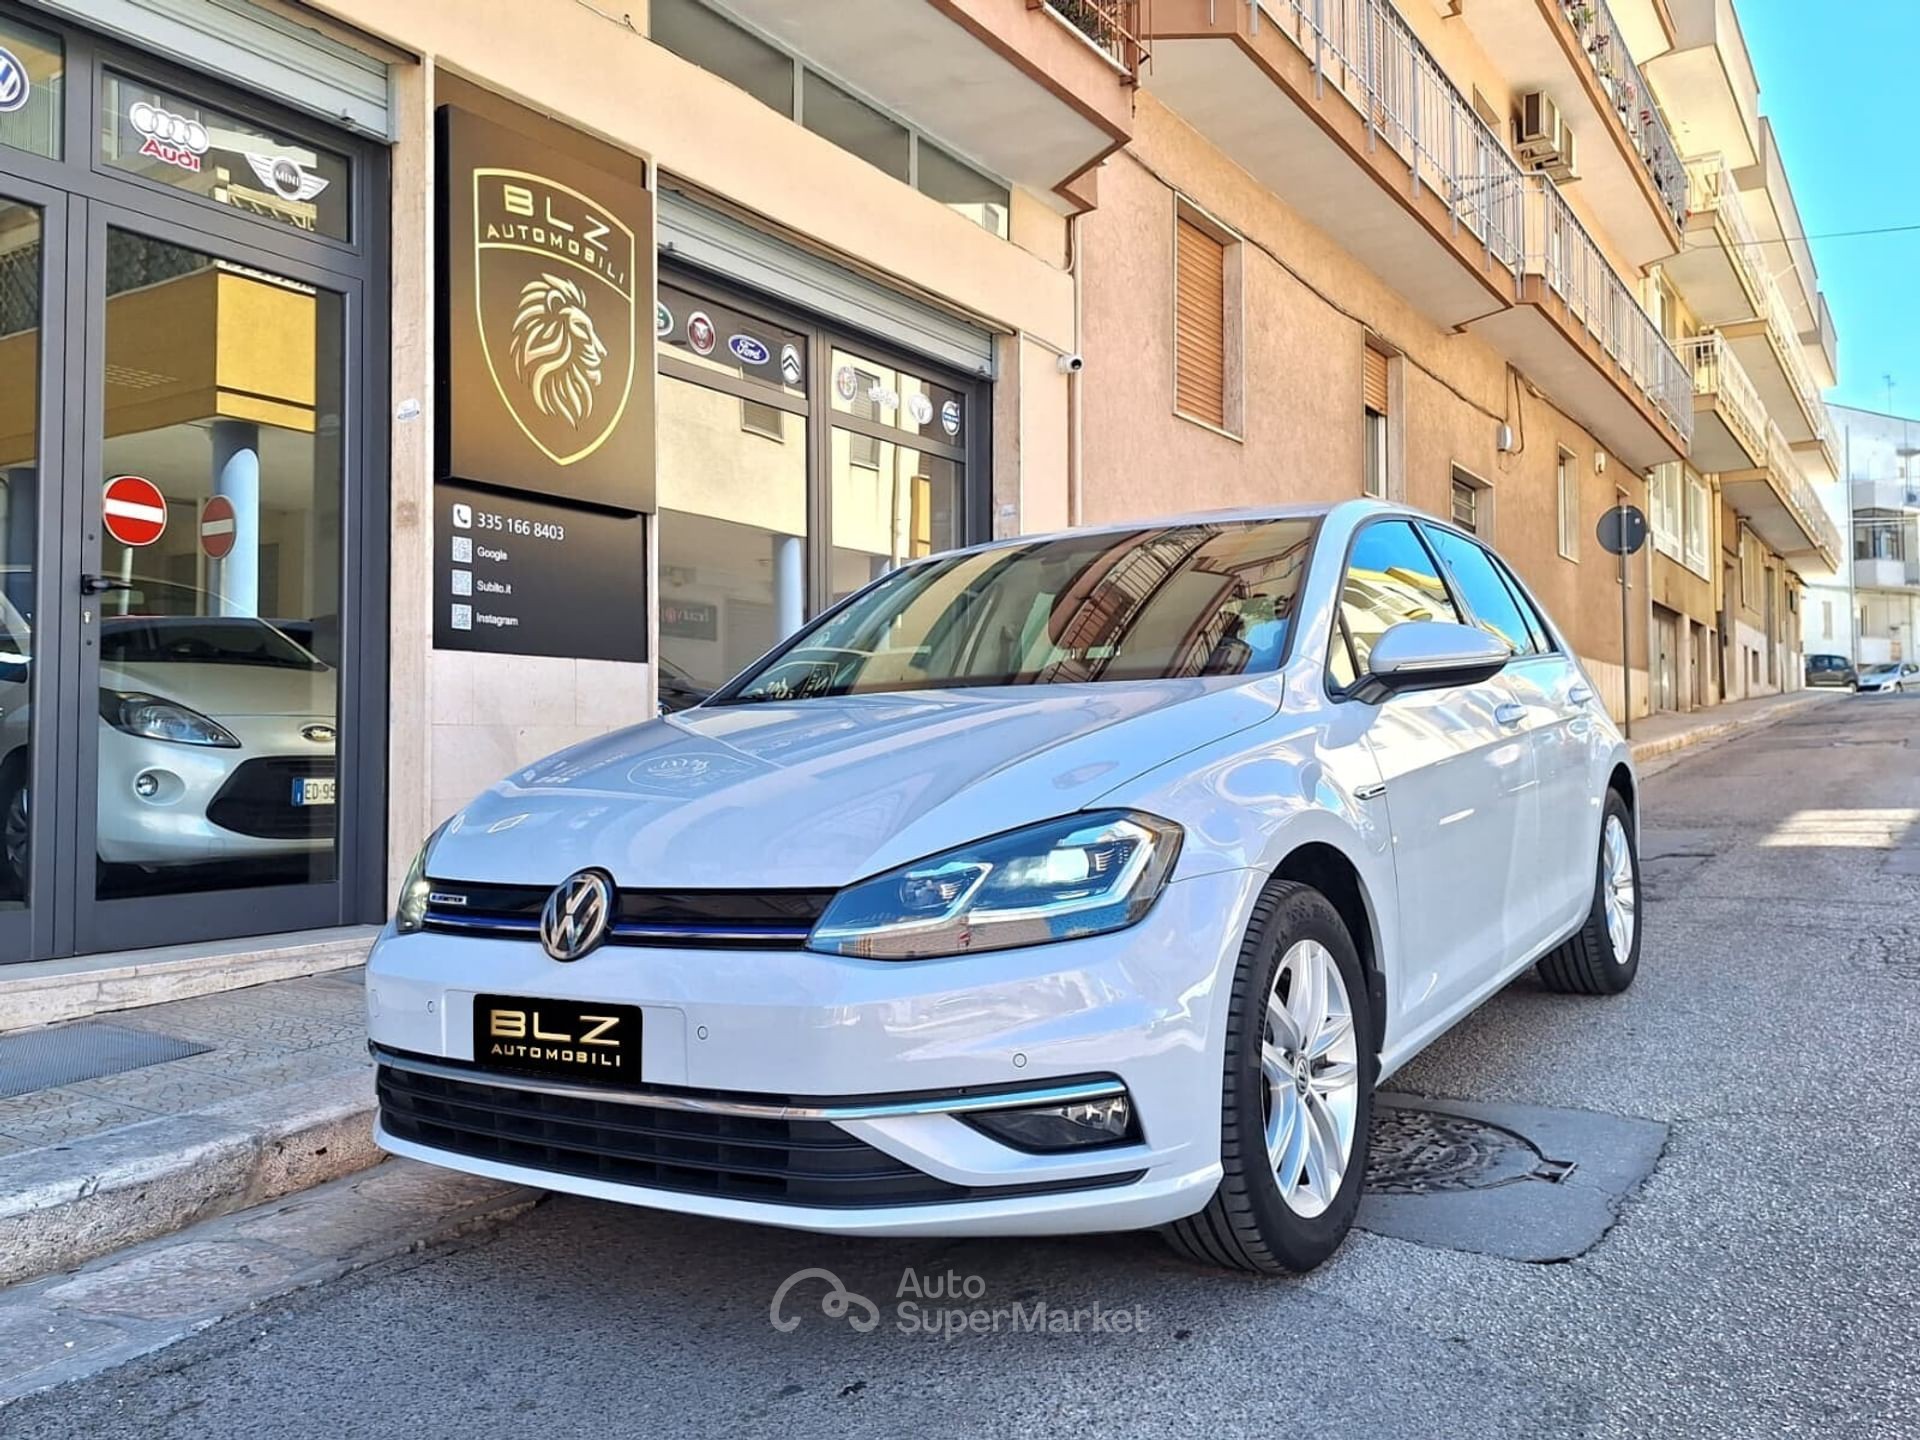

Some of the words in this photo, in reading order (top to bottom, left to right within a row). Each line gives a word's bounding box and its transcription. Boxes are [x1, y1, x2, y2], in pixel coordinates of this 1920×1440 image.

[142, 139, 199, 170] Audi
[275, 170, 299, 187] MINI
[504, 184, 611, 251] BLZ
[487, 223, 624, 284] AUTOMOBILI
[477, 512, 502, 531] 335
[507, 518, 530, 535] 166
[533, 522, 564, 540] 8403
[477, 546, 508, 561] Google
[476, 612, 519, 627] Instagram
[491, 1009, 620, 1045] BLZ
[491, 1043, 620, 1067] AUTOMOBILI
